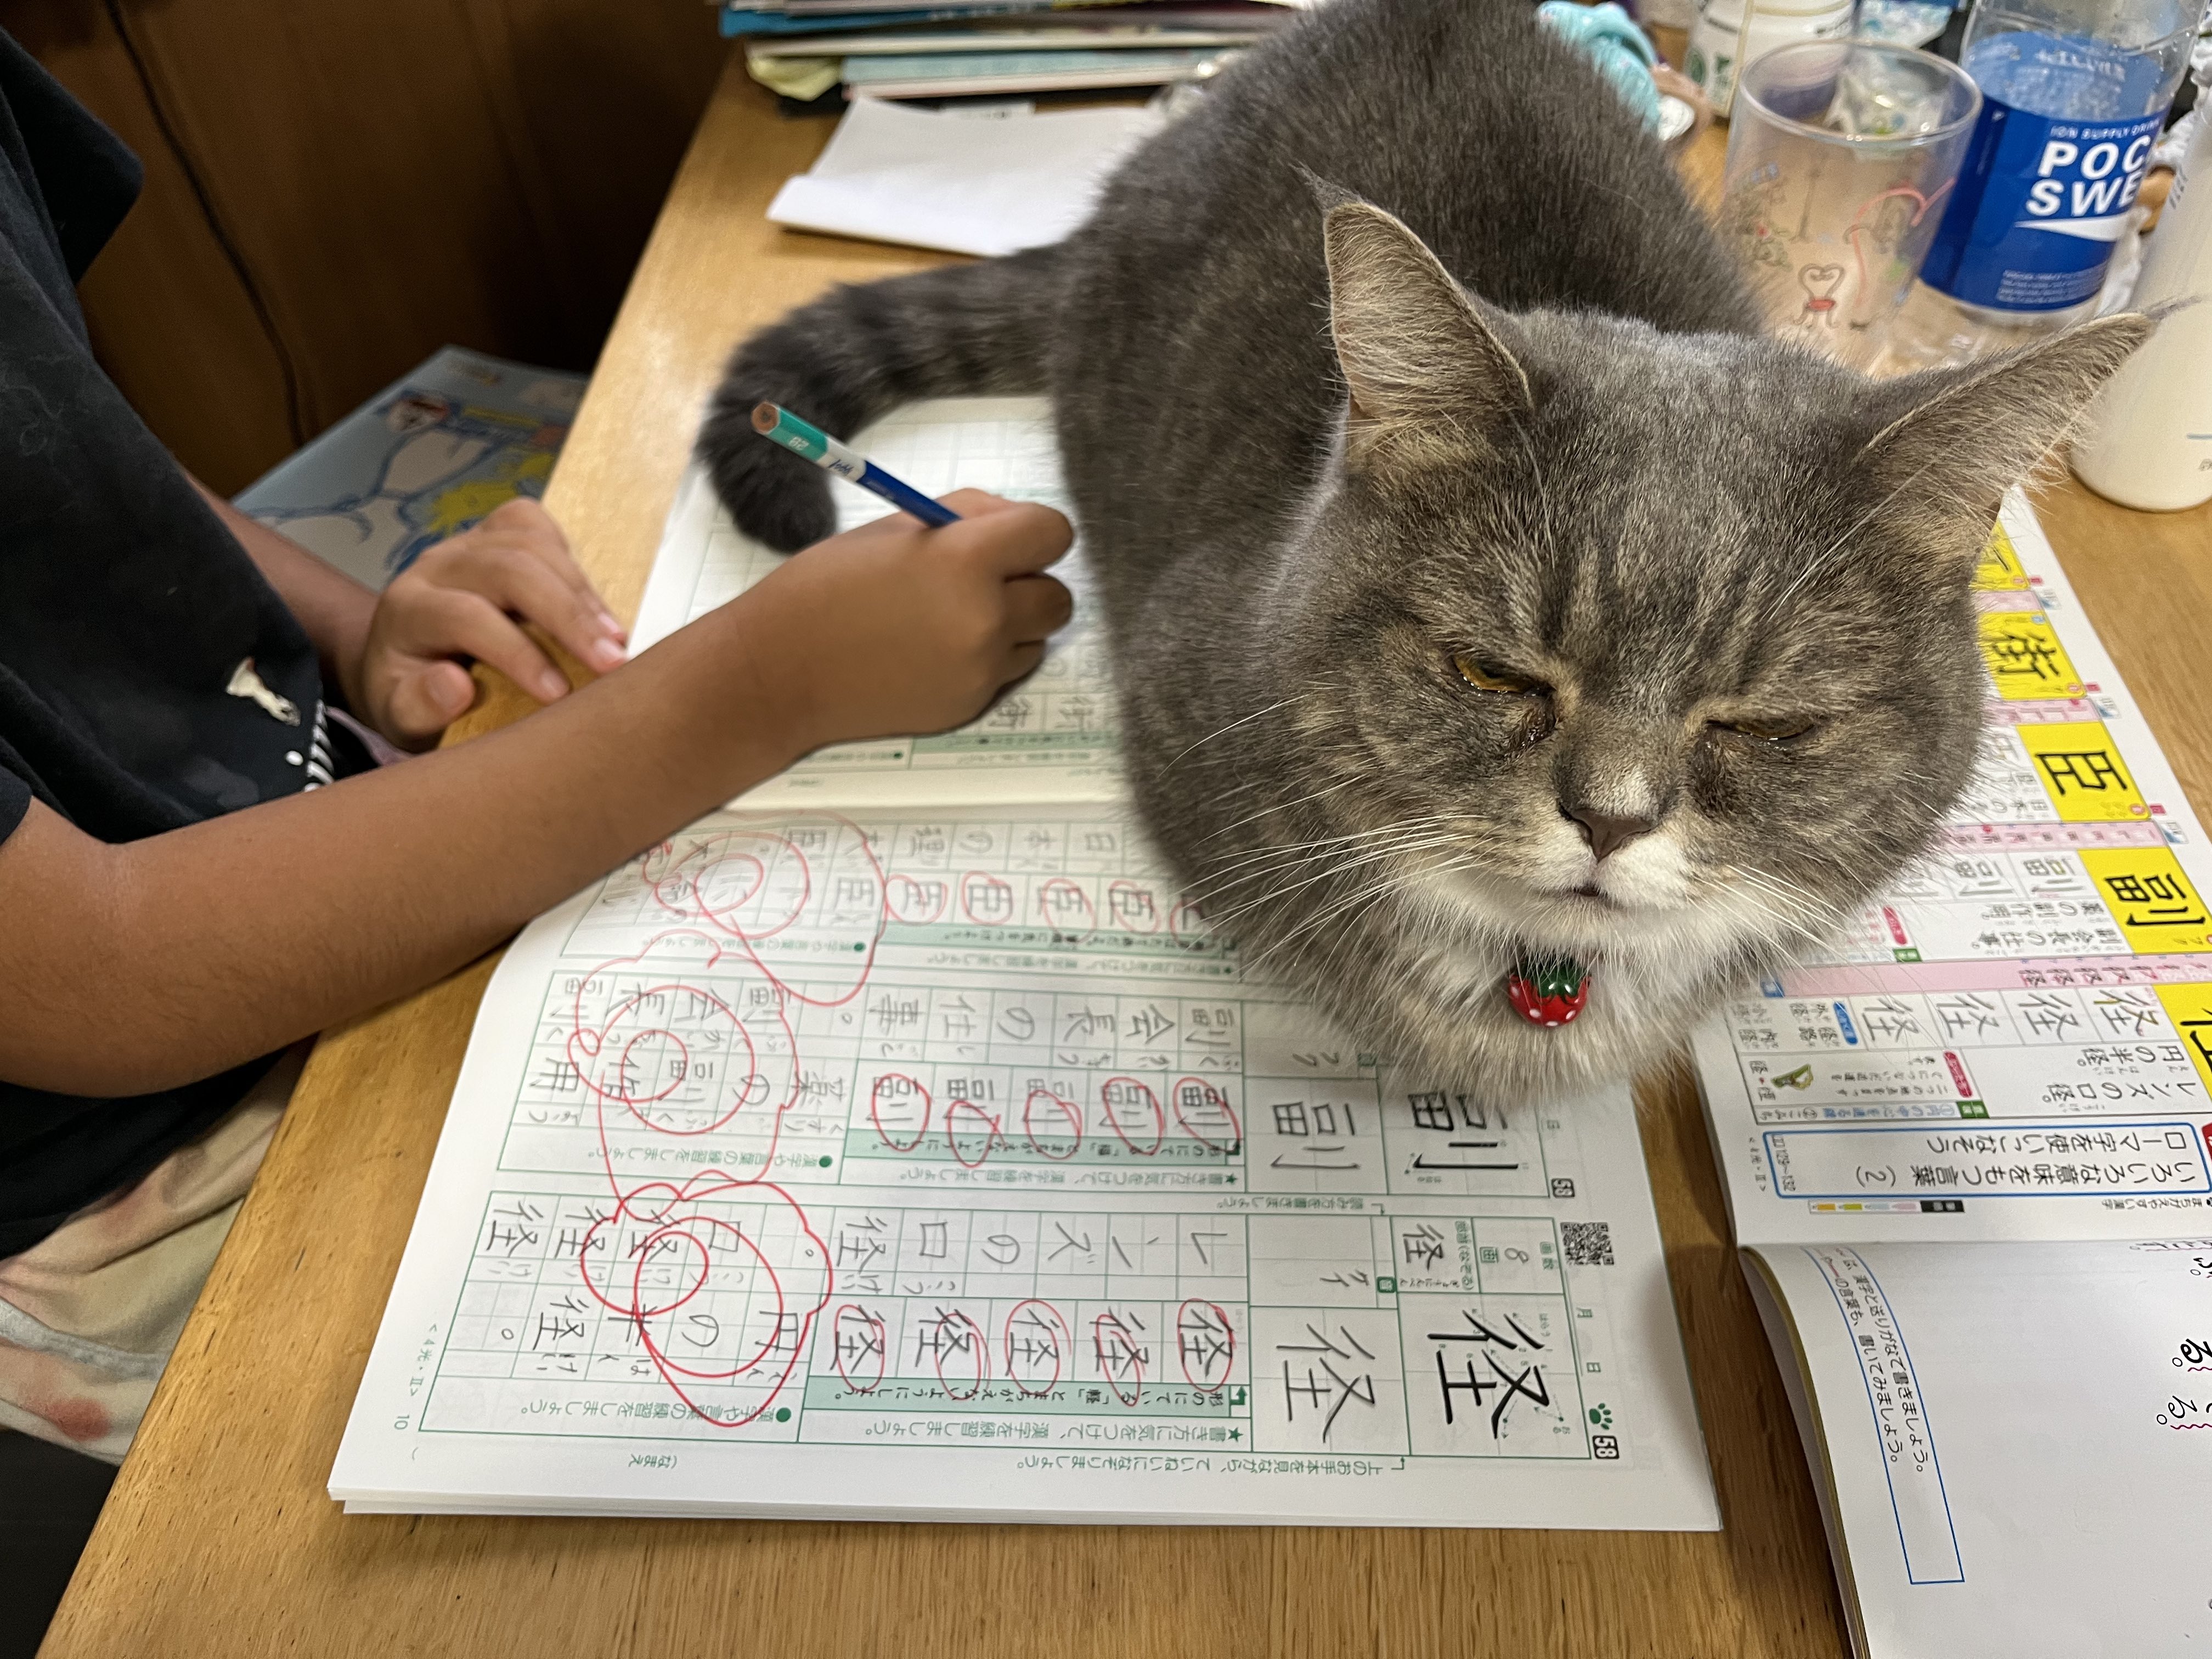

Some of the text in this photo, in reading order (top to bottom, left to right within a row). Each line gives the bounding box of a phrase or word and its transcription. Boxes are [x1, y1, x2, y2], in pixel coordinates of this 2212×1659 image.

[2034, 752, 2128, 796] 臣
[2103, 873, 2206, 927] 副
[2041, 1081, 2197, 1104] レンズの口径。
[1271, 1101, 1362, 1170] 副
[1408, 1091, 1519, 1170] 副
[1926, 1131, 2187, 1154] ローマ字を使いこなそう
[1910, 1162, 2196, 1187] いろいろな意味をもつ言葉
[1402, 1223, 1445, 1272] 径
[1504, 1247, 1530, 1263] 8
[1576, 1307, 1601, 1373] 月 日
[1276, 1323, 1376, 1444] 径
[1427, 1310, 1550, 1440] 径
[393, 1414, 410, 1431] 10
[1017, 1455, 1384, 1476] 上のお手本を見ながら、ていねいになぞりましょう。
[1594, 1437, 1617, 1457] 58
